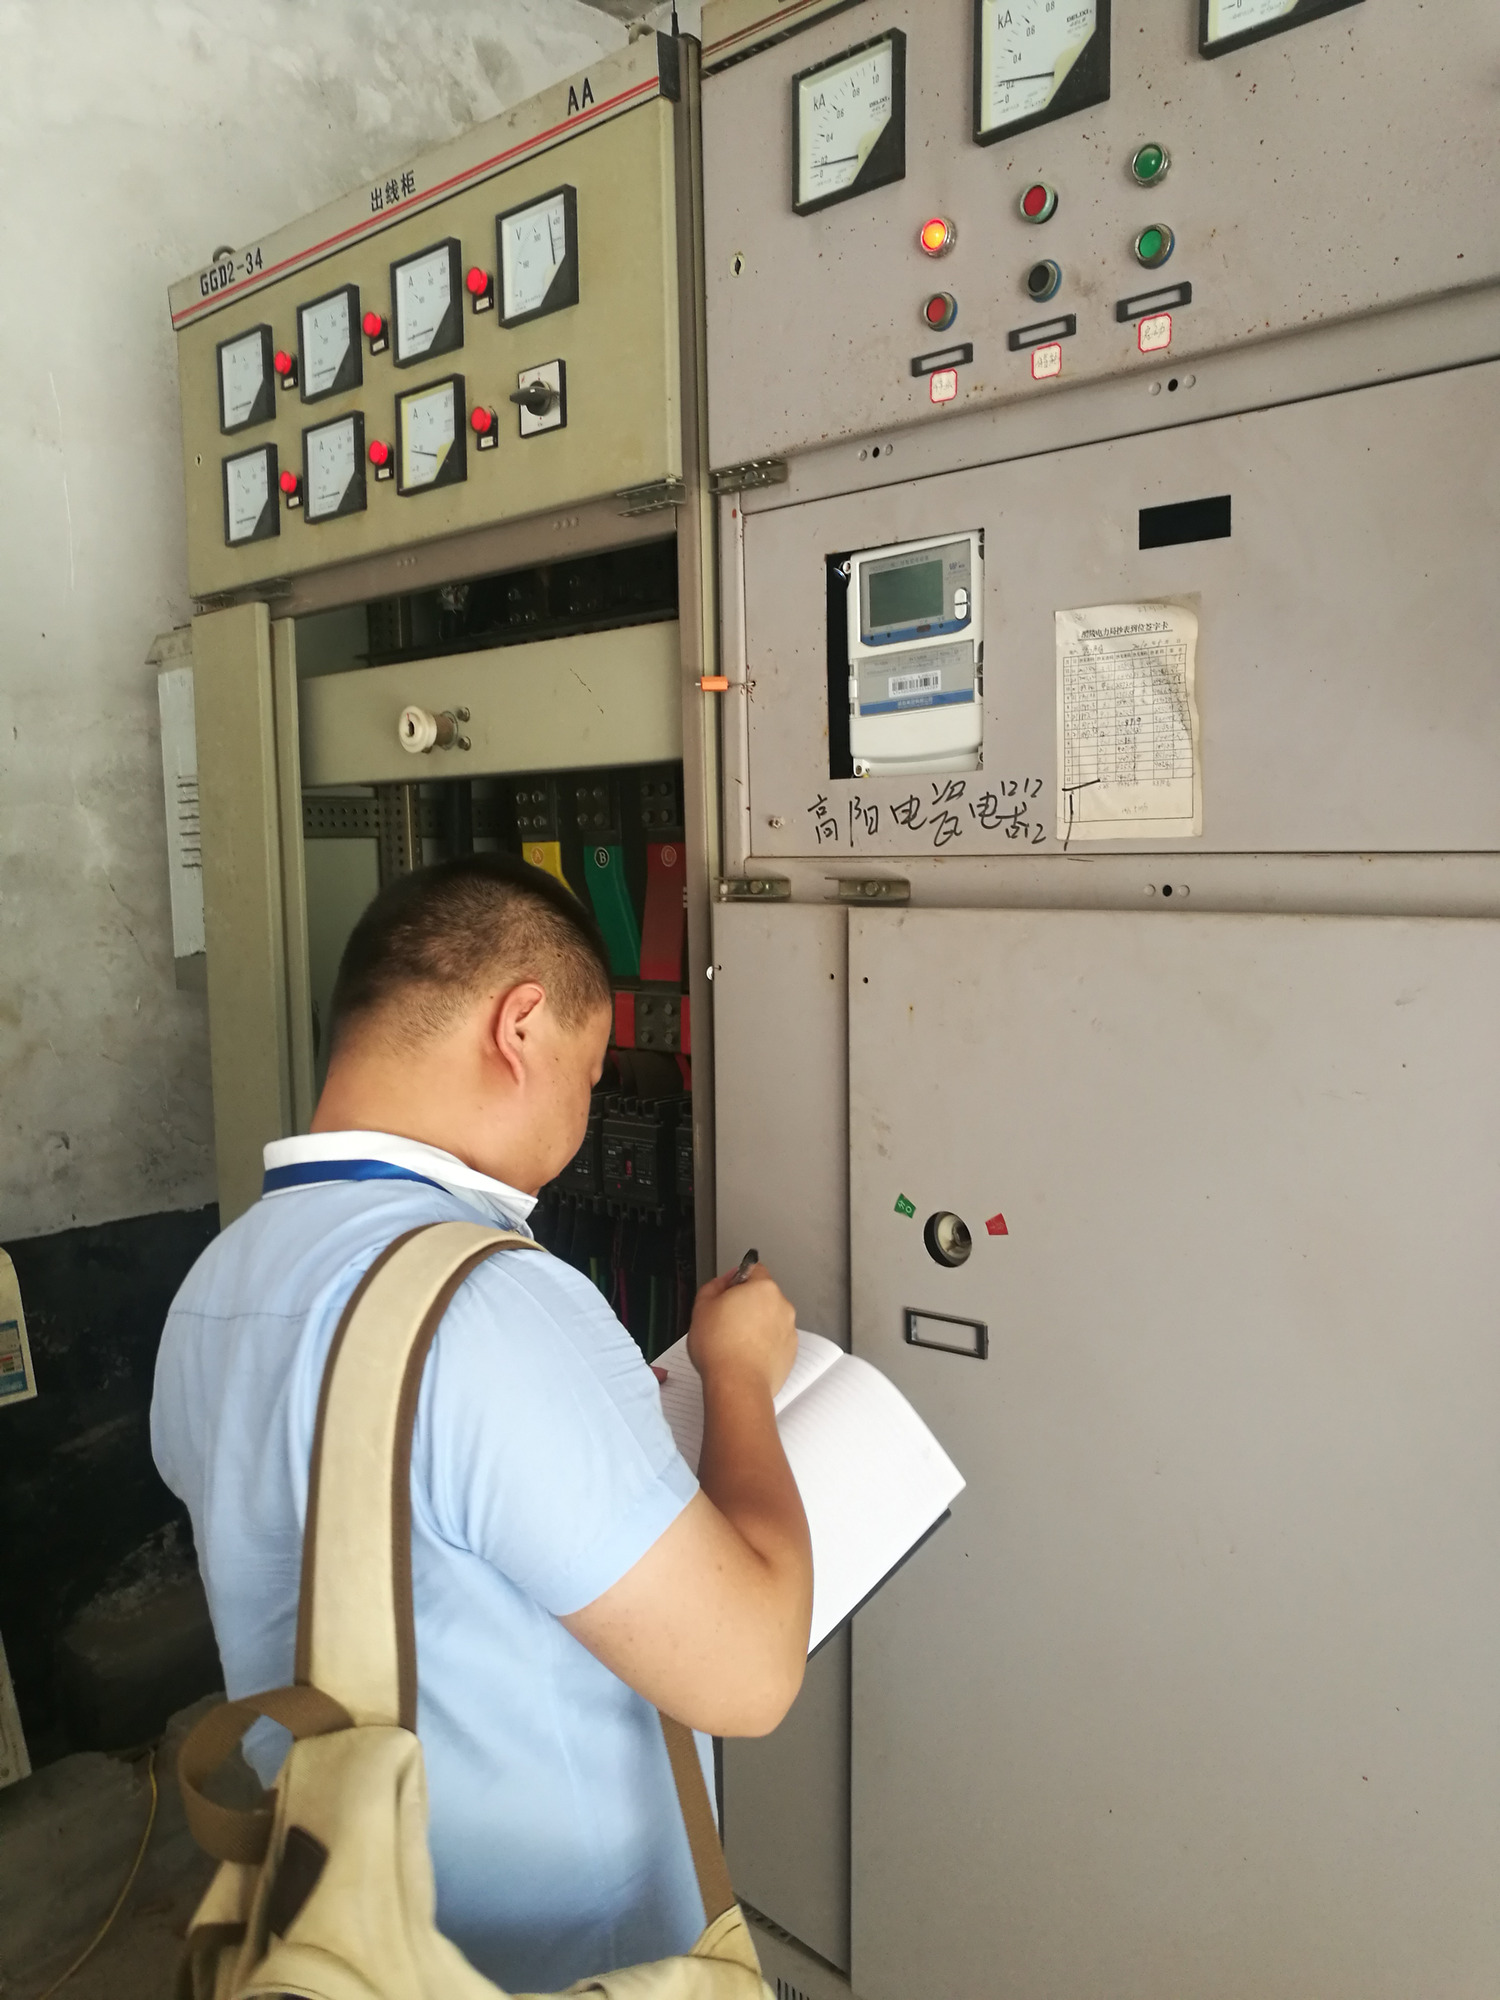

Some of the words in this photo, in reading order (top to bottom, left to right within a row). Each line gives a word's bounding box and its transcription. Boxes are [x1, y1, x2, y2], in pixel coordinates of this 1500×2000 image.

[997, 10, 1012, 30] kA
[567, 77, 594, 116] AA
[813, 93, 826, 112] kA
[371, 169, 416, 212] 出线柜
[200, 247, 263, 296] GGD2-34
[599, 851, 608, 864] B
